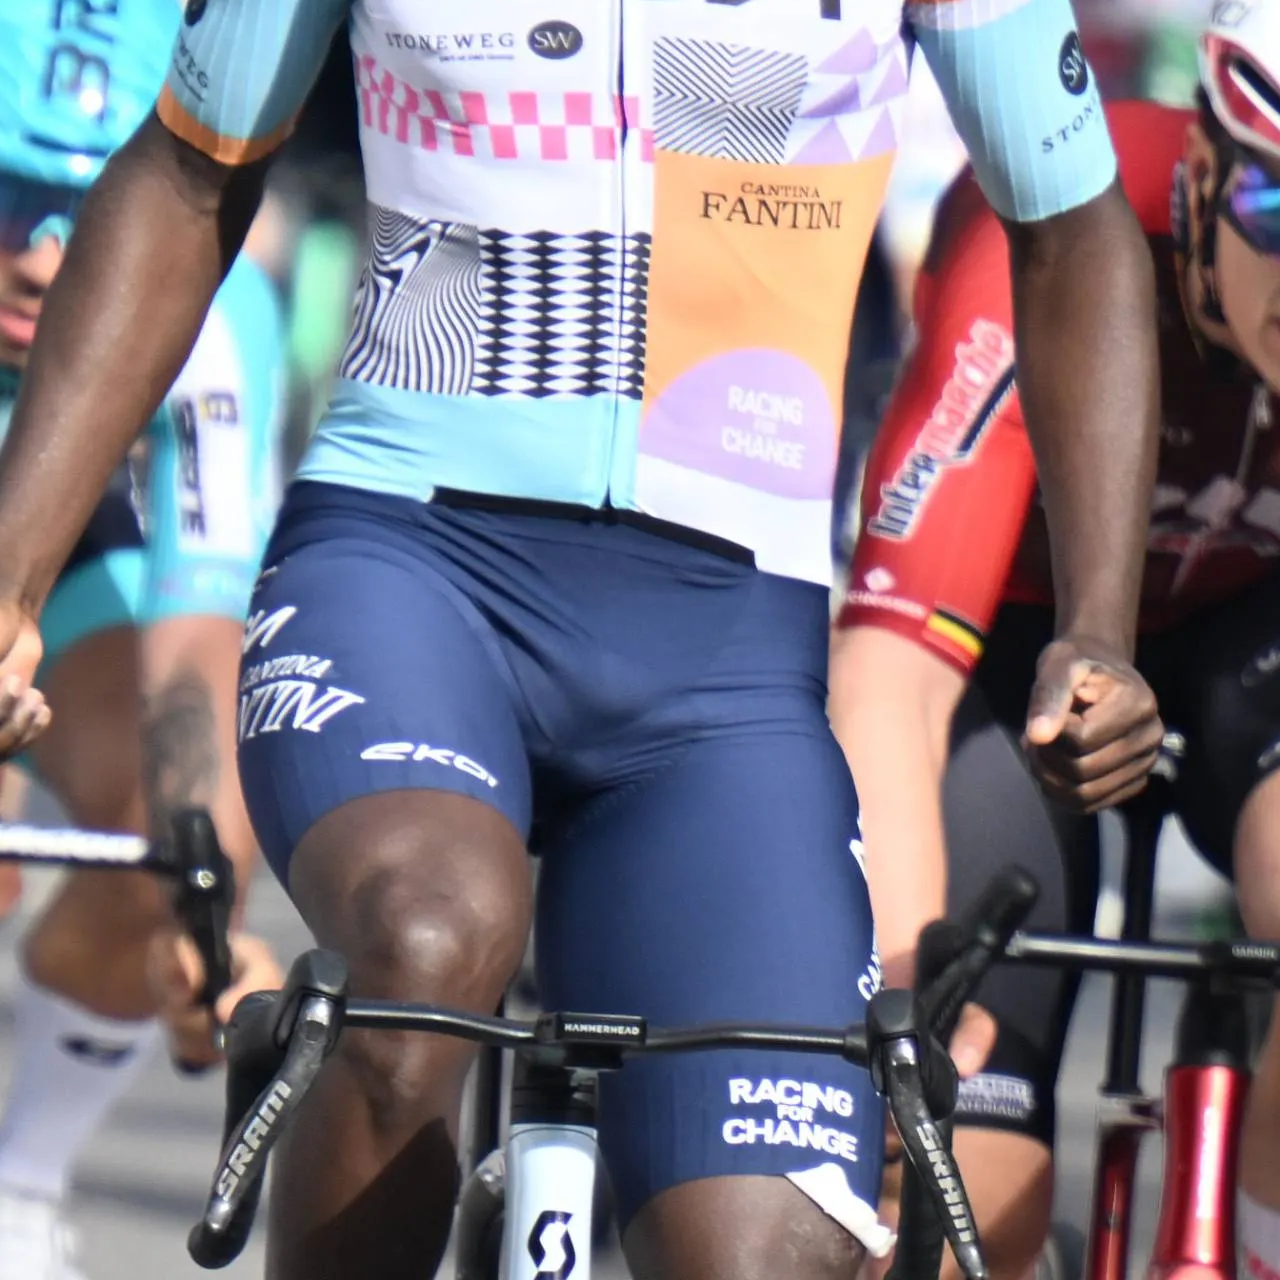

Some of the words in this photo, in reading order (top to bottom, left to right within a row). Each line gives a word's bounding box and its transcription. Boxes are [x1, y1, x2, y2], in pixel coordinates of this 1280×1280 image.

[699, 190, 843, 231] FANTINI
[740, 181, 821, 199] CANTINA
[727, 384, 803, 426] RACING
[721, 425, 805, 471] CHANGE
[563, 1023, 640, 1035] HAMMERHEAD
[728, 1077, 854, 1118] RACING
[776, 1104, 815, 1122] FOR
[217, 1080, 292, 1202] SRAM
[722, 1118, 859, 1163] CHANGE
